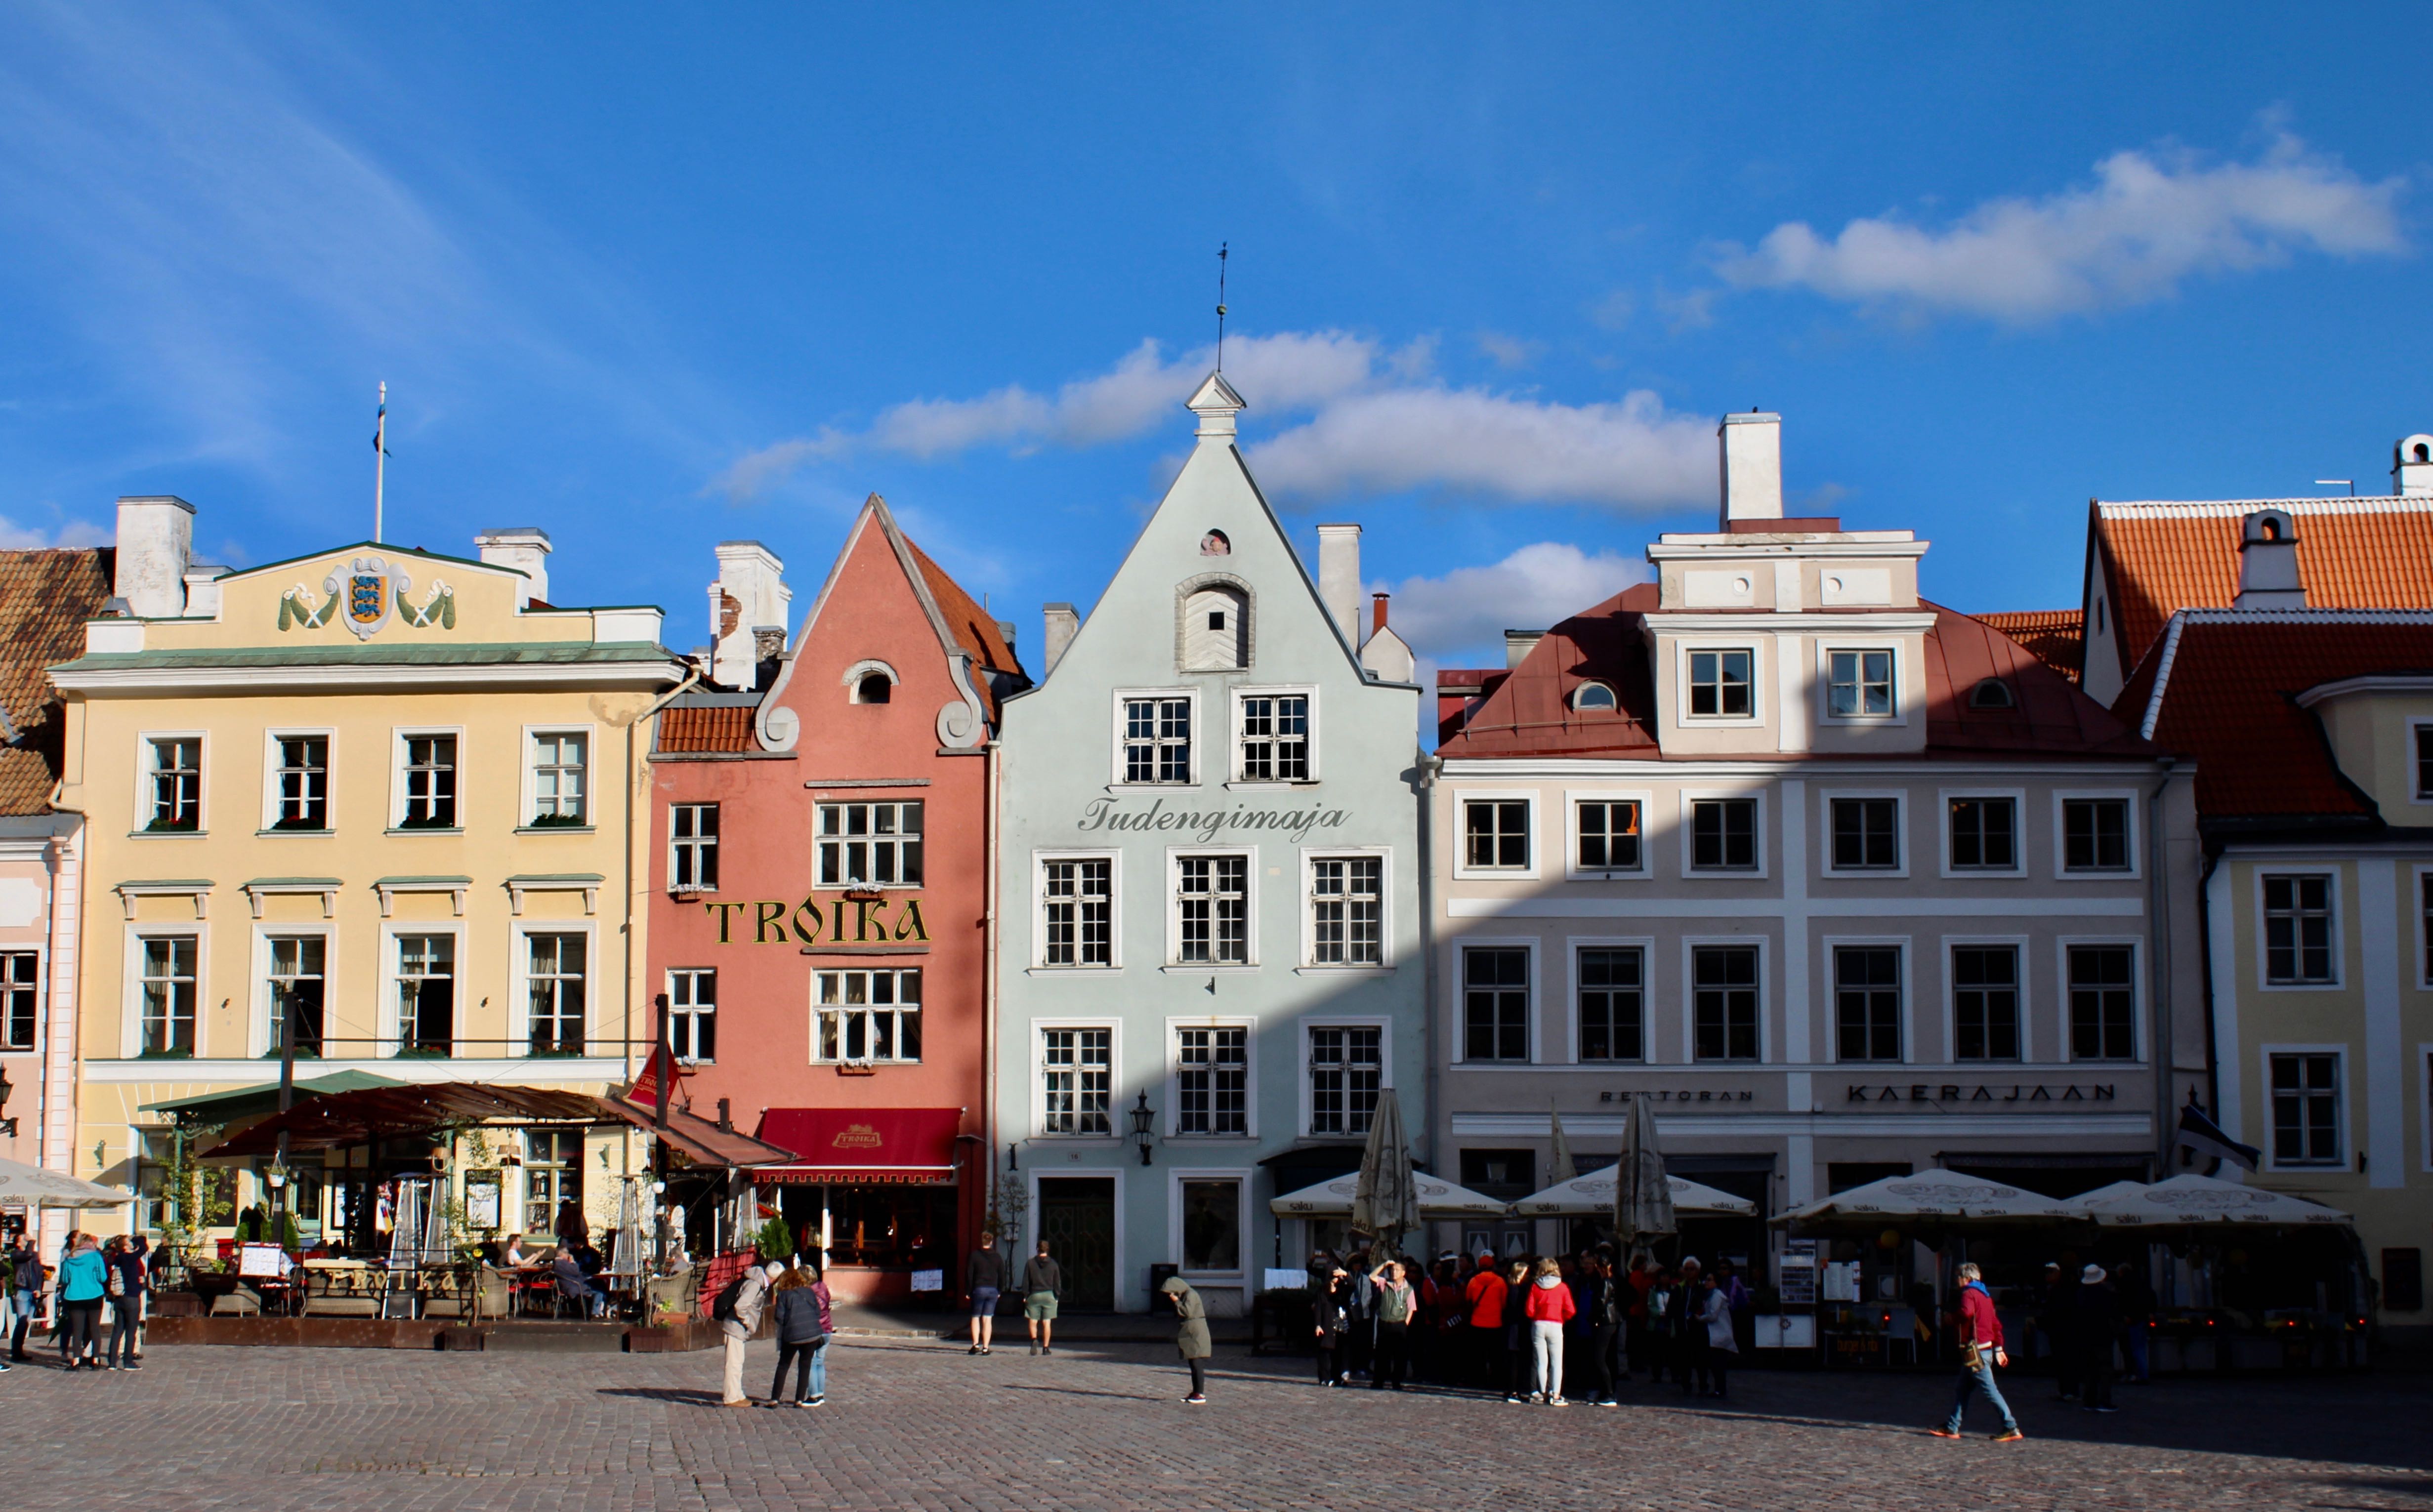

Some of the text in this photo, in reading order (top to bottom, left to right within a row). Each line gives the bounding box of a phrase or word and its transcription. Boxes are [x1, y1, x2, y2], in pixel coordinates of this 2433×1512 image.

[1078, 797, 1353, 843] Tudengimaja
[705, 894, 932, 945] TROIKA
[1848, 1085, 2114, 1101] KAERAJAAN
[3, 1194, 24, 1203] saku
[1290, 1201, 1312, 1210] saku
[1536, 1203, 1560, 1212] saku
[2116, 1214, 2142, 1224] saku
